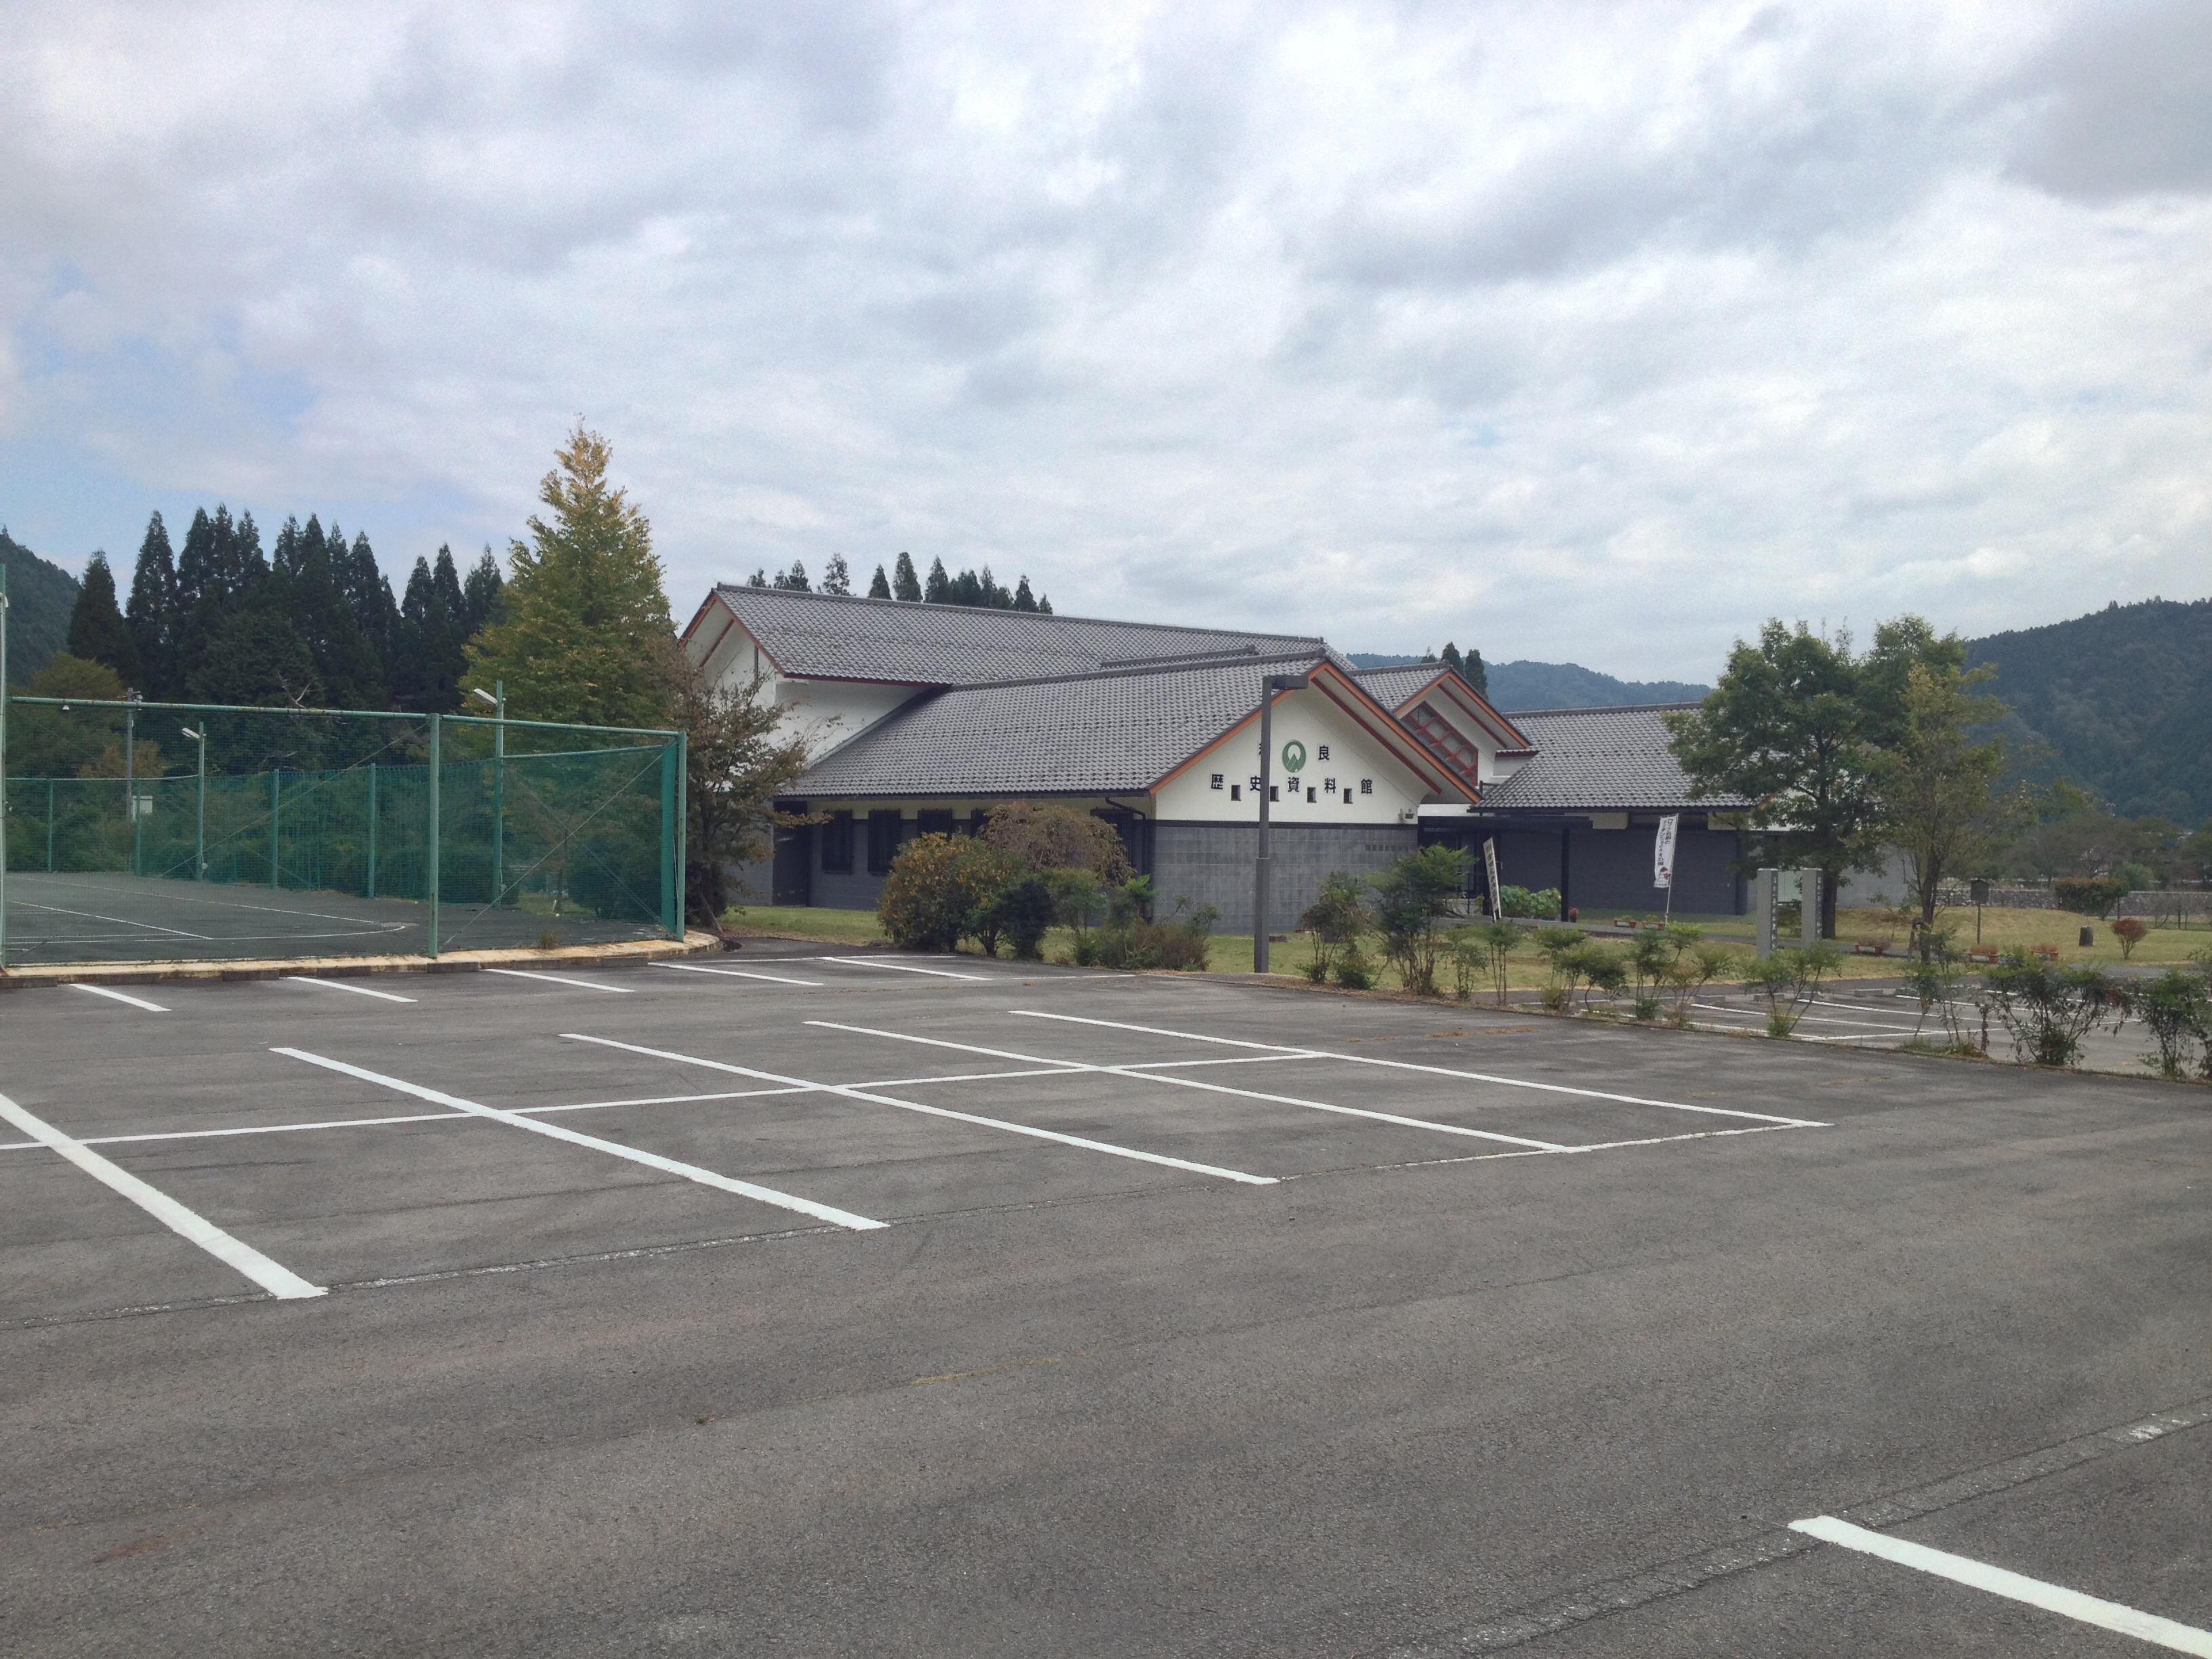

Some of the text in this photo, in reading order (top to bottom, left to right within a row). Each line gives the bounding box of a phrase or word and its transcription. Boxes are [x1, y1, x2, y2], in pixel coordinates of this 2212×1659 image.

[1210, 773, 1373, 794] 歴史資料館
